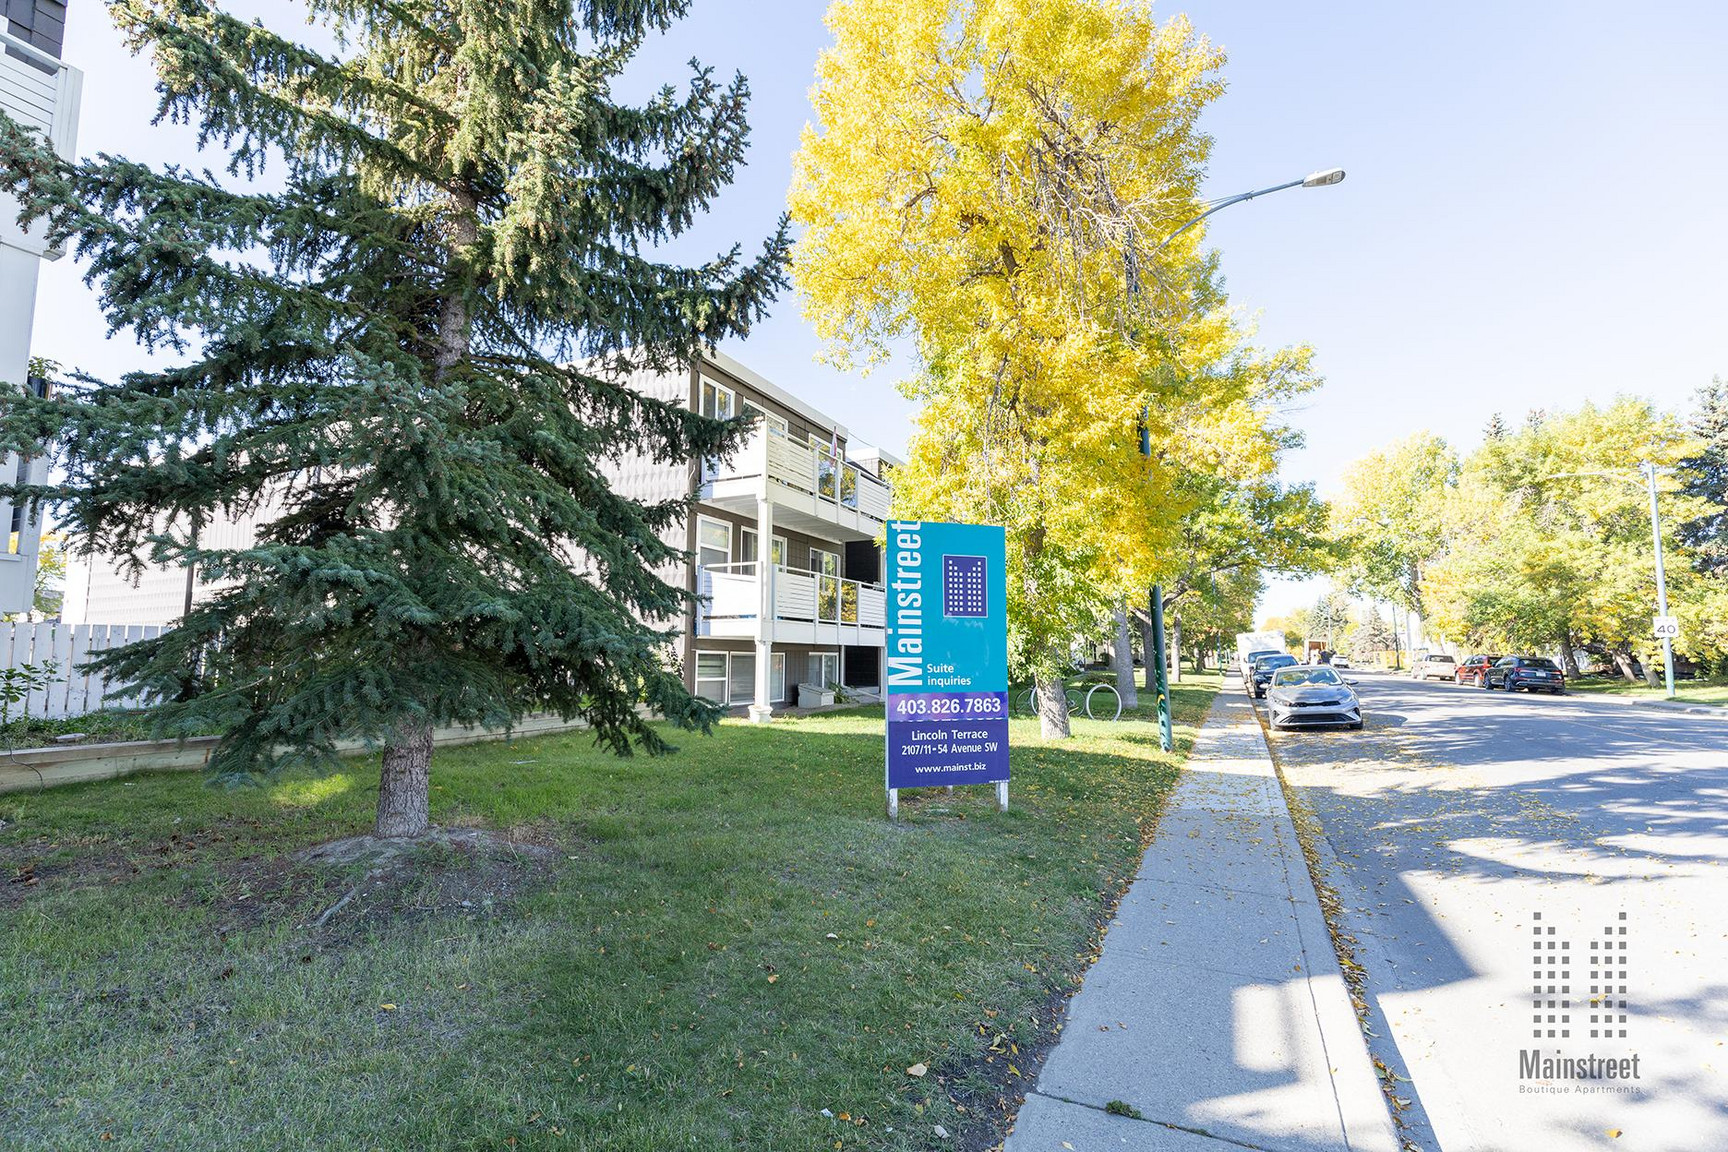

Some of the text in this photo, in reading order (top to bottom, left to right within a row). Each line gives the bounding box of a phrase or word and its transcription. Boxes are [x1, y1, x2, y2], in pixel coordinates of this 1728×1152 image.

[888, 521, 922, 685] Mainstreet
[1657, 625, 1676, 633] 40
[927, 663, 954, 673] Suite
[927, 676, 971, 687] inquiries
[897, 698, 1001, 714] 403.826.7863
[912, 729, 988, 741] Lincoln Terrace
[951, 743, 982, 753] Avenue
[984, 742, 998, 752] SW
[915, 762, 986, 773] www.mainst.biz
